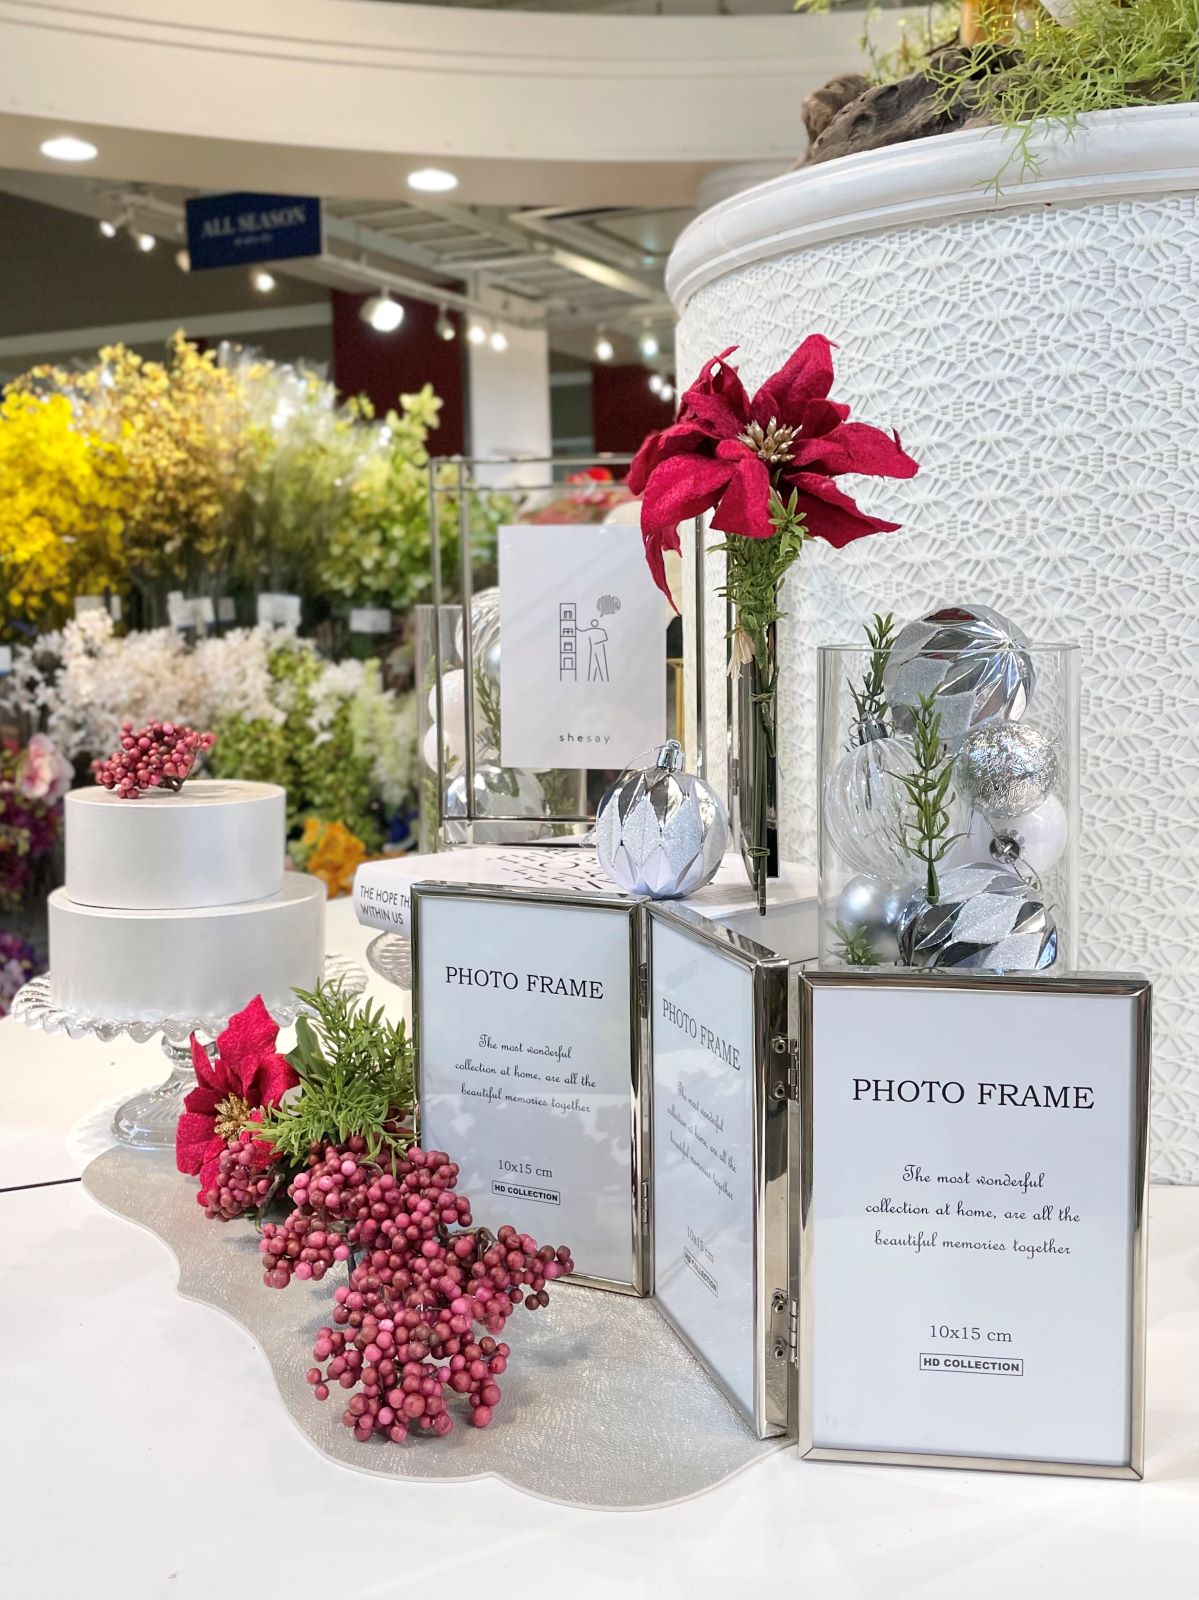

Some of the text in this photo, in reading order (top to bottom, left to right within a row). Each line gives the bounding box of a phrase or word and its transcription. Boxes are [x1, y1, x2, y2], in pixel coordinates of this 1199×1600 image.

[202, 206, 306, 238] ALL SEASON
[559, 733, 610, 744] shesay
[360, 885, 411, 909] THE HOPE TH
[360, 903, 404, 925] WITHIN US
[445, 966, 604, 1000] PHOTO FRAME
[478, 1034, 572, 1063] The most wonderful
[662, 998, 741, 1071] PHOTO FRAME
[455, 1058, 597, 1088] collection at home, are all the
[461, 1083, 590, 1115] beautiful memories together
[852, 1078, 1095, 1109] PHOTO FRAME
[499, 1159, 553, 1178] 10x15 cm
[902, 1164, 1045, 1194] The most wonderful
[494, 1184, 558, 1201] HD COLLECTION
[865, 1198, 1080, 1223] collection at home, are all the
[874, 1230, 1071, 1259] beautiful memories together
[930, 1325, 1013, 1342] 10x15 cm
[923, 1358, 1019, 1371] HD COLLECTION
